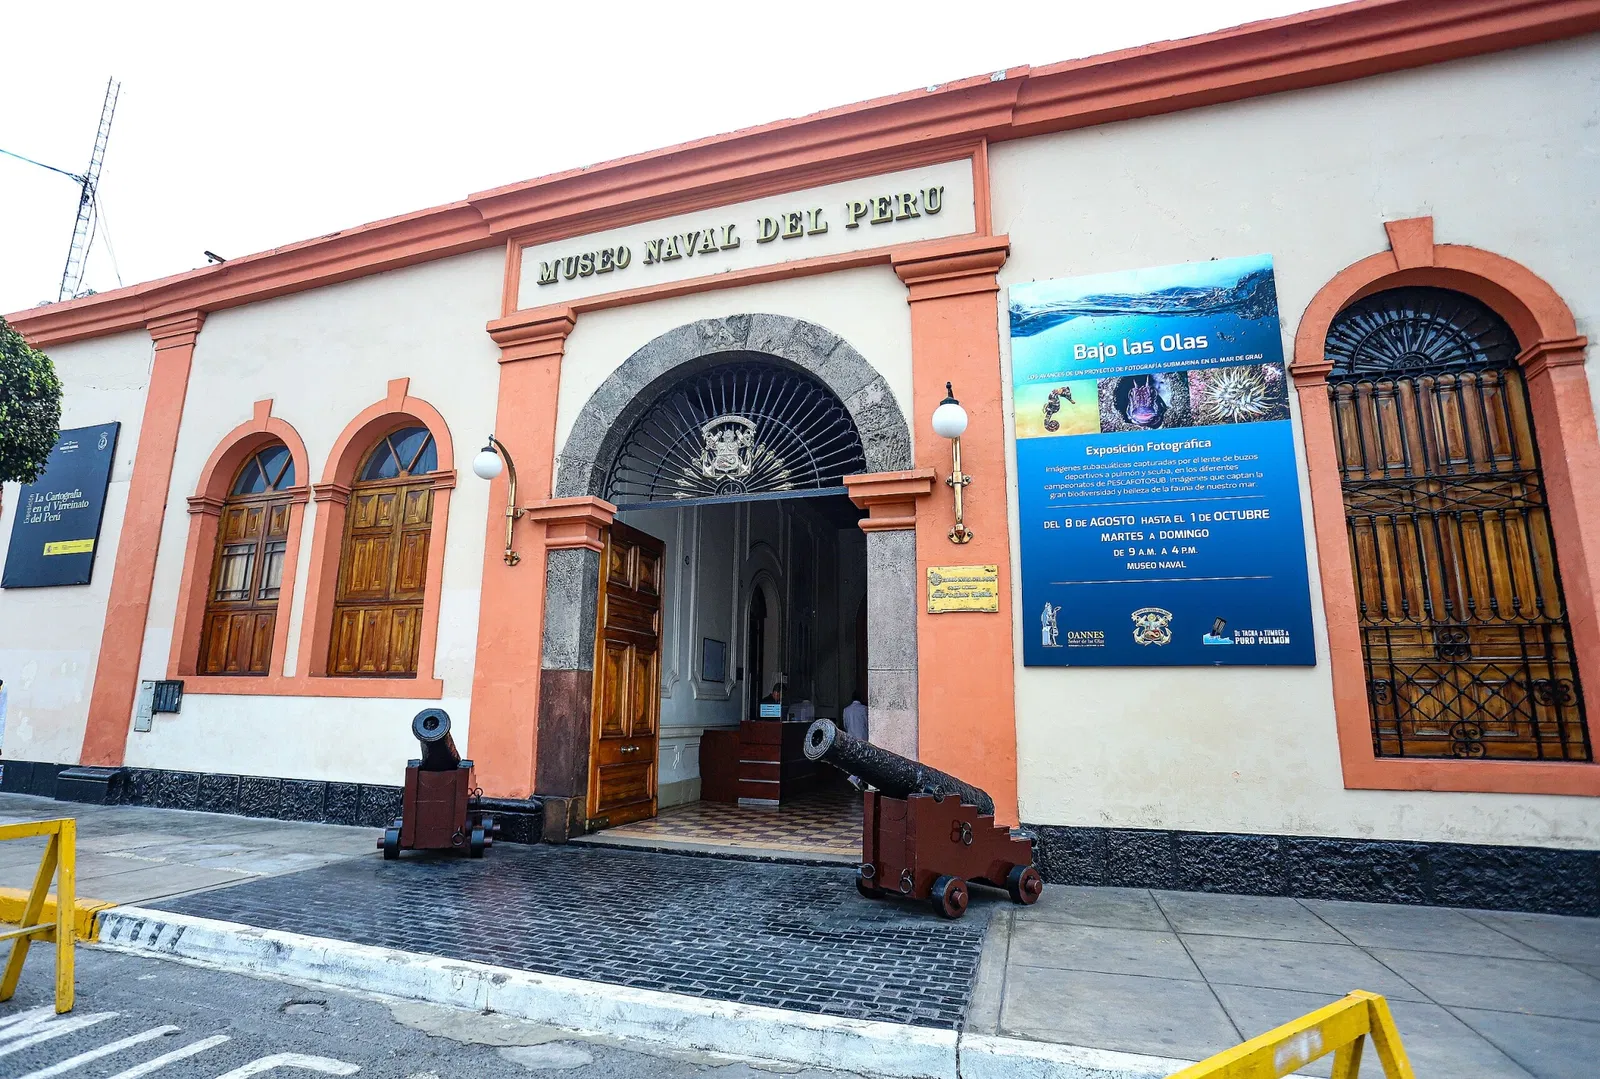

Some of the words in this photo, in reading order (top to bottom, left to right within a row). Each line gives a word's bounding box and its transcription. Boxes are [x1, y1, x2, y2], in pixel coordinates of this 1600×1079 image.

[537, 246, 631, 286] MUSEO
[643, 224, 740, 265] NAVAL
[756, 208, 828, 244] DEL
[846, 186, 945, 229] PERU
[1074, 342, 1117, 363] Bajo
[1122, 336, 1154, 355] las
[1160, 333, 1208, 352] Olas
[1040, 371, 1065, 379] AVANCES
[1163, 360, 1199, 368] SUBMARINA
[1086, 443, 1144, 456] Exposición
[1147, 438, 1211, 452] Fotográfica
[1083, 462, 1131, 470] subacuáticas
[1133, 458, 1176, 468] capturadas
[1065, 472, 1103, 480] deportivos
[1112, 470, 1140, 478] pulmón
[1199, 464, 1238, 472] diferentes
[1044, 482, 1094, 490] campeonatos
[35, 493, 44, 502] La
[1068, 488, 1115, 497] biodiversidad
[44, 502, 51, 512] el
[53, 500, 89, 510] Virreinato
[31, 513, 42, 523] del
[43, 511, 61, 522] Perú
[1065, 518, 1072, 528] 8
[1075, 519, 1087, 527] DE
[1090, 516, 1135, 527] AGOSTO
[1141, 515, 1171, 525] HASTA
[1174, 515, 1185, 523] EL
[1190, 513, 1195, 522] 1
[1199, 513, 1211, 522] DE
[1214, 509, 1270, 521] OCTUBRE
[1101, 532, 1144, 542] MARTES
[1159, 529, 1209, 540] DOMINGO
[1128, 548, 1135, 556] 9
[1172, 546, 1179, 554] 4
[1127, 562, 1157, 570] MUSEO
[1068, 631, 1104, 639] OANNES
